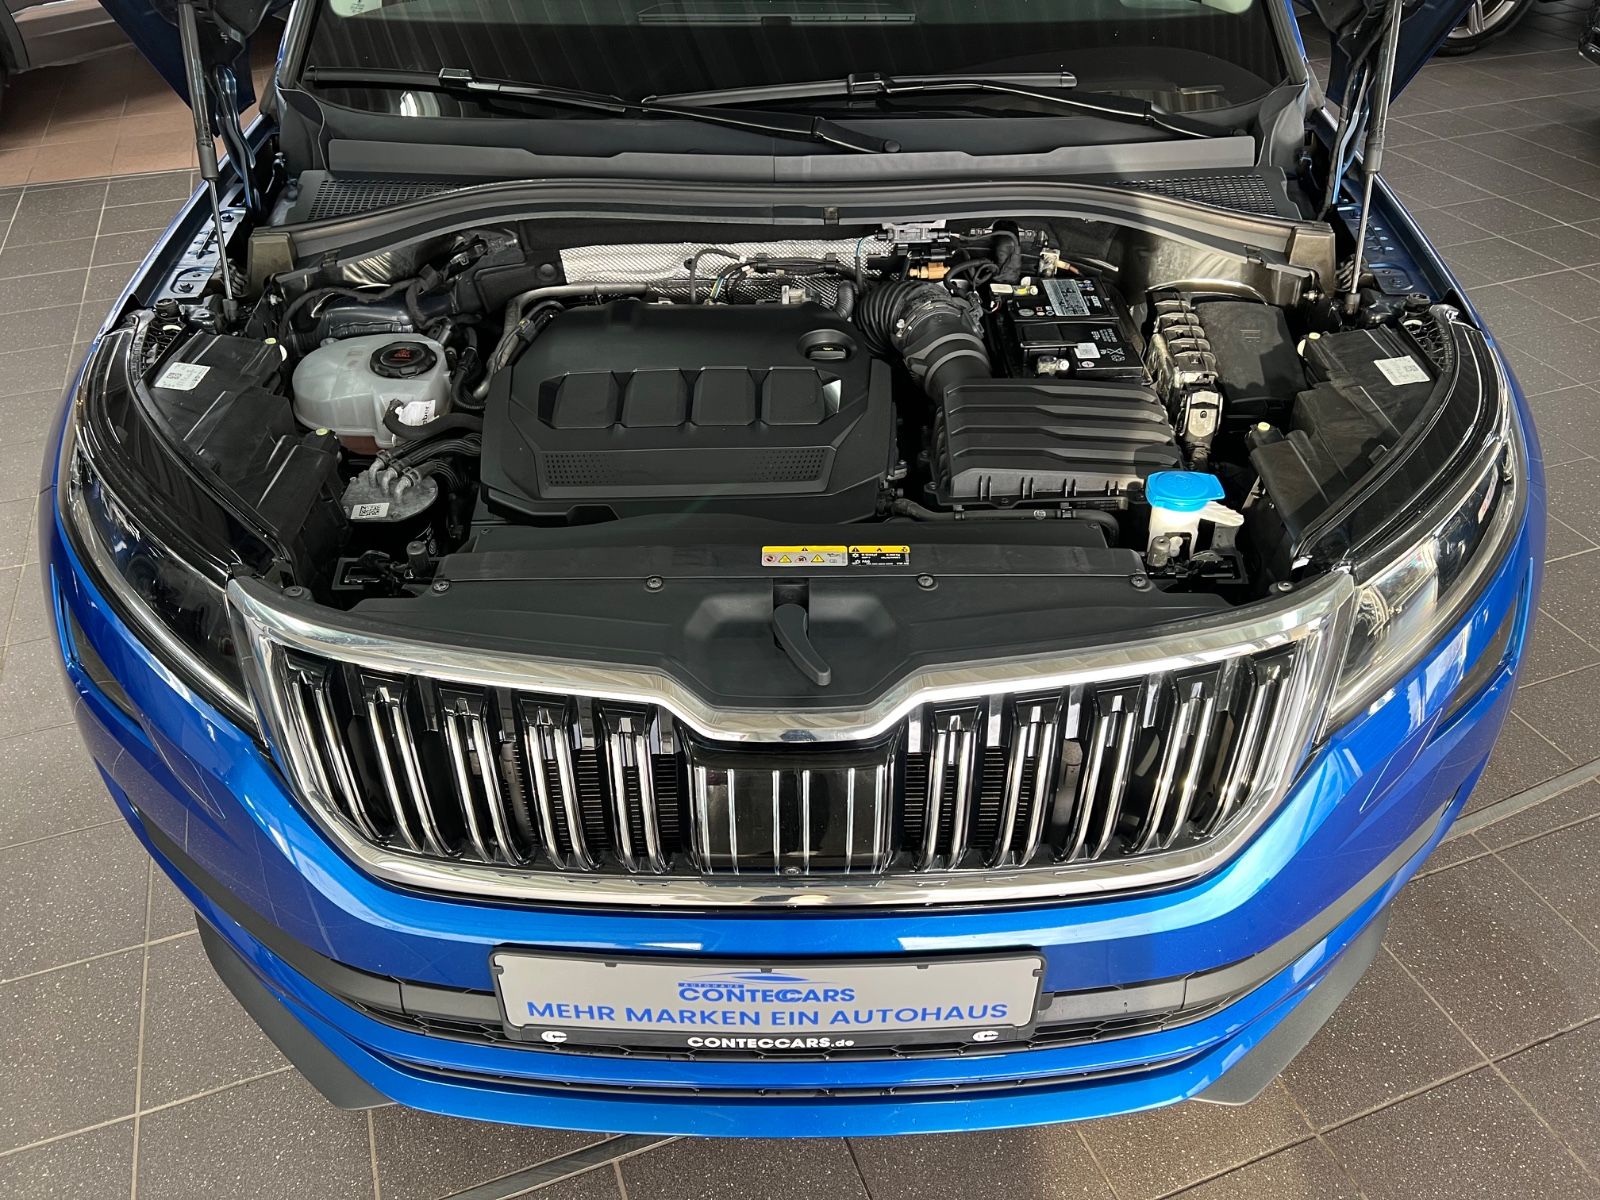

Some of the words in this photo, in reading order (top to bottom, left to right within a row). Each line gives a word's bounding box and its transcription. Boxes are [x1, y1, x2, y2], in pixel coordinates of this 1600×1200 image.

[527, 1001, 615, 1021] MEHR
[625, 1007, 761, 1026] MARKEN
[771, 1011, 819, 1026] EIN
[829, 1004, 1008, 1025] AUTOHAUS
[687, 1036, 855, 1049] CONTECCARS.de
